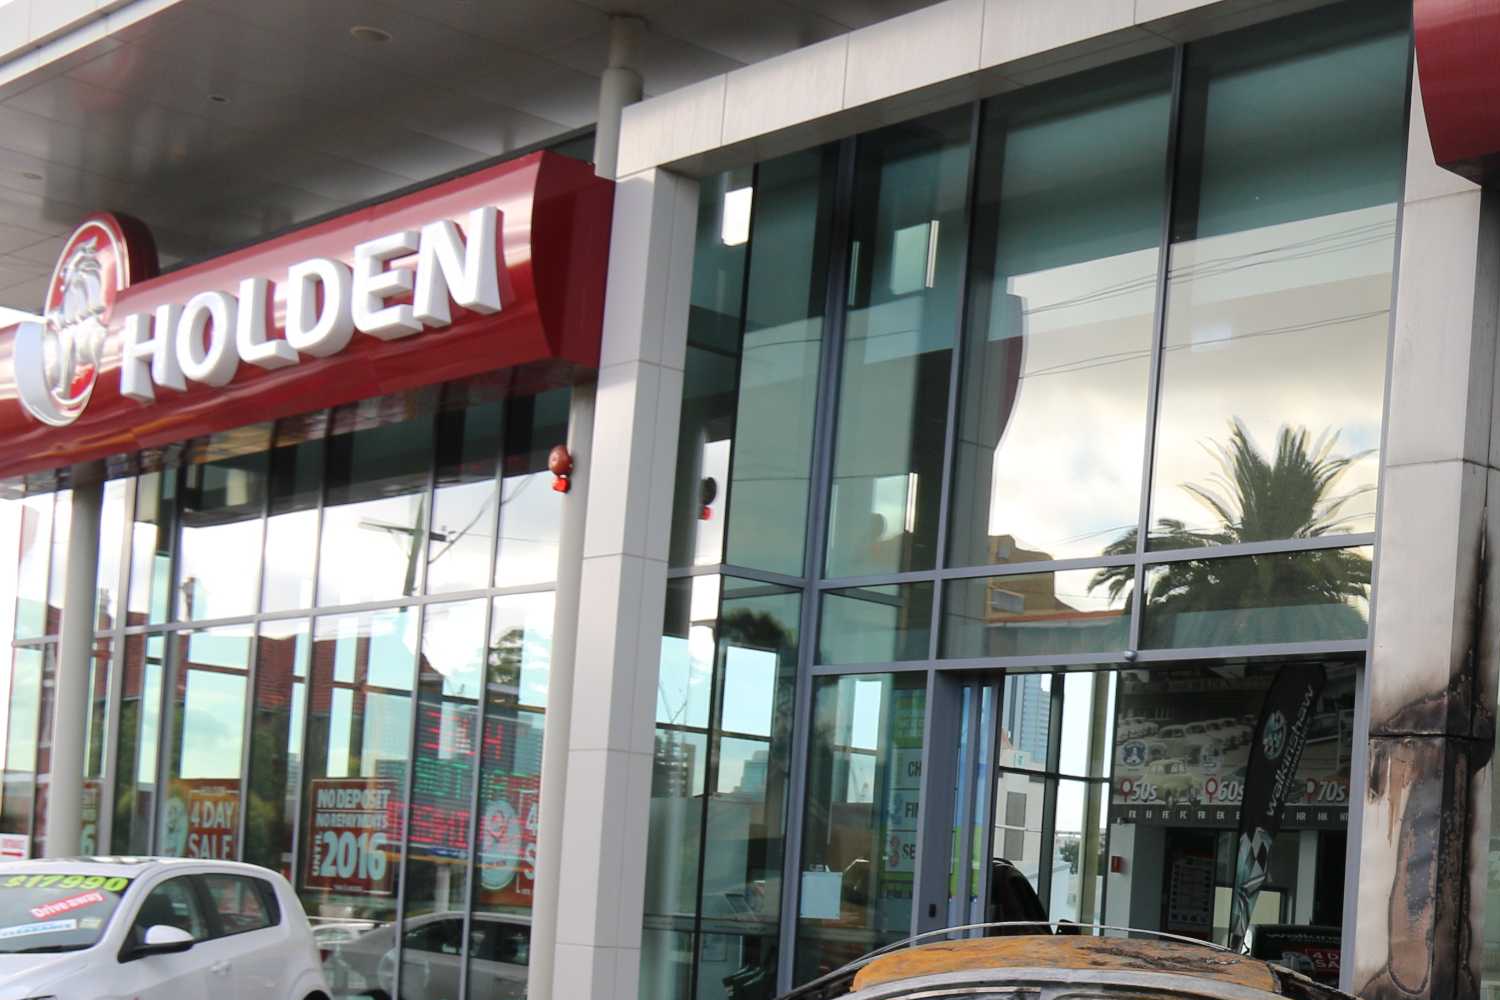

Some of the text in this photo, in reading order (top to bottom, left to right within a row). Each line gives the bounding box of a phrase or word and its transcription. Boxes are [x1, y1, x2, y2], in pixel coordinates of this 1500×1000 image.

[120, 206, 502, 400] HOLDEN
[317, 789, 336, 808] NO
[1132, 781, 1158, 800] 50s
[1317, 781, 1346, 801] 70s
[202, 800, 234, 829] DAY
[188, 832, 233, 860] SALE
[320, 831, 388, 881] 2016
[3, 875, 129, 892] $17990
